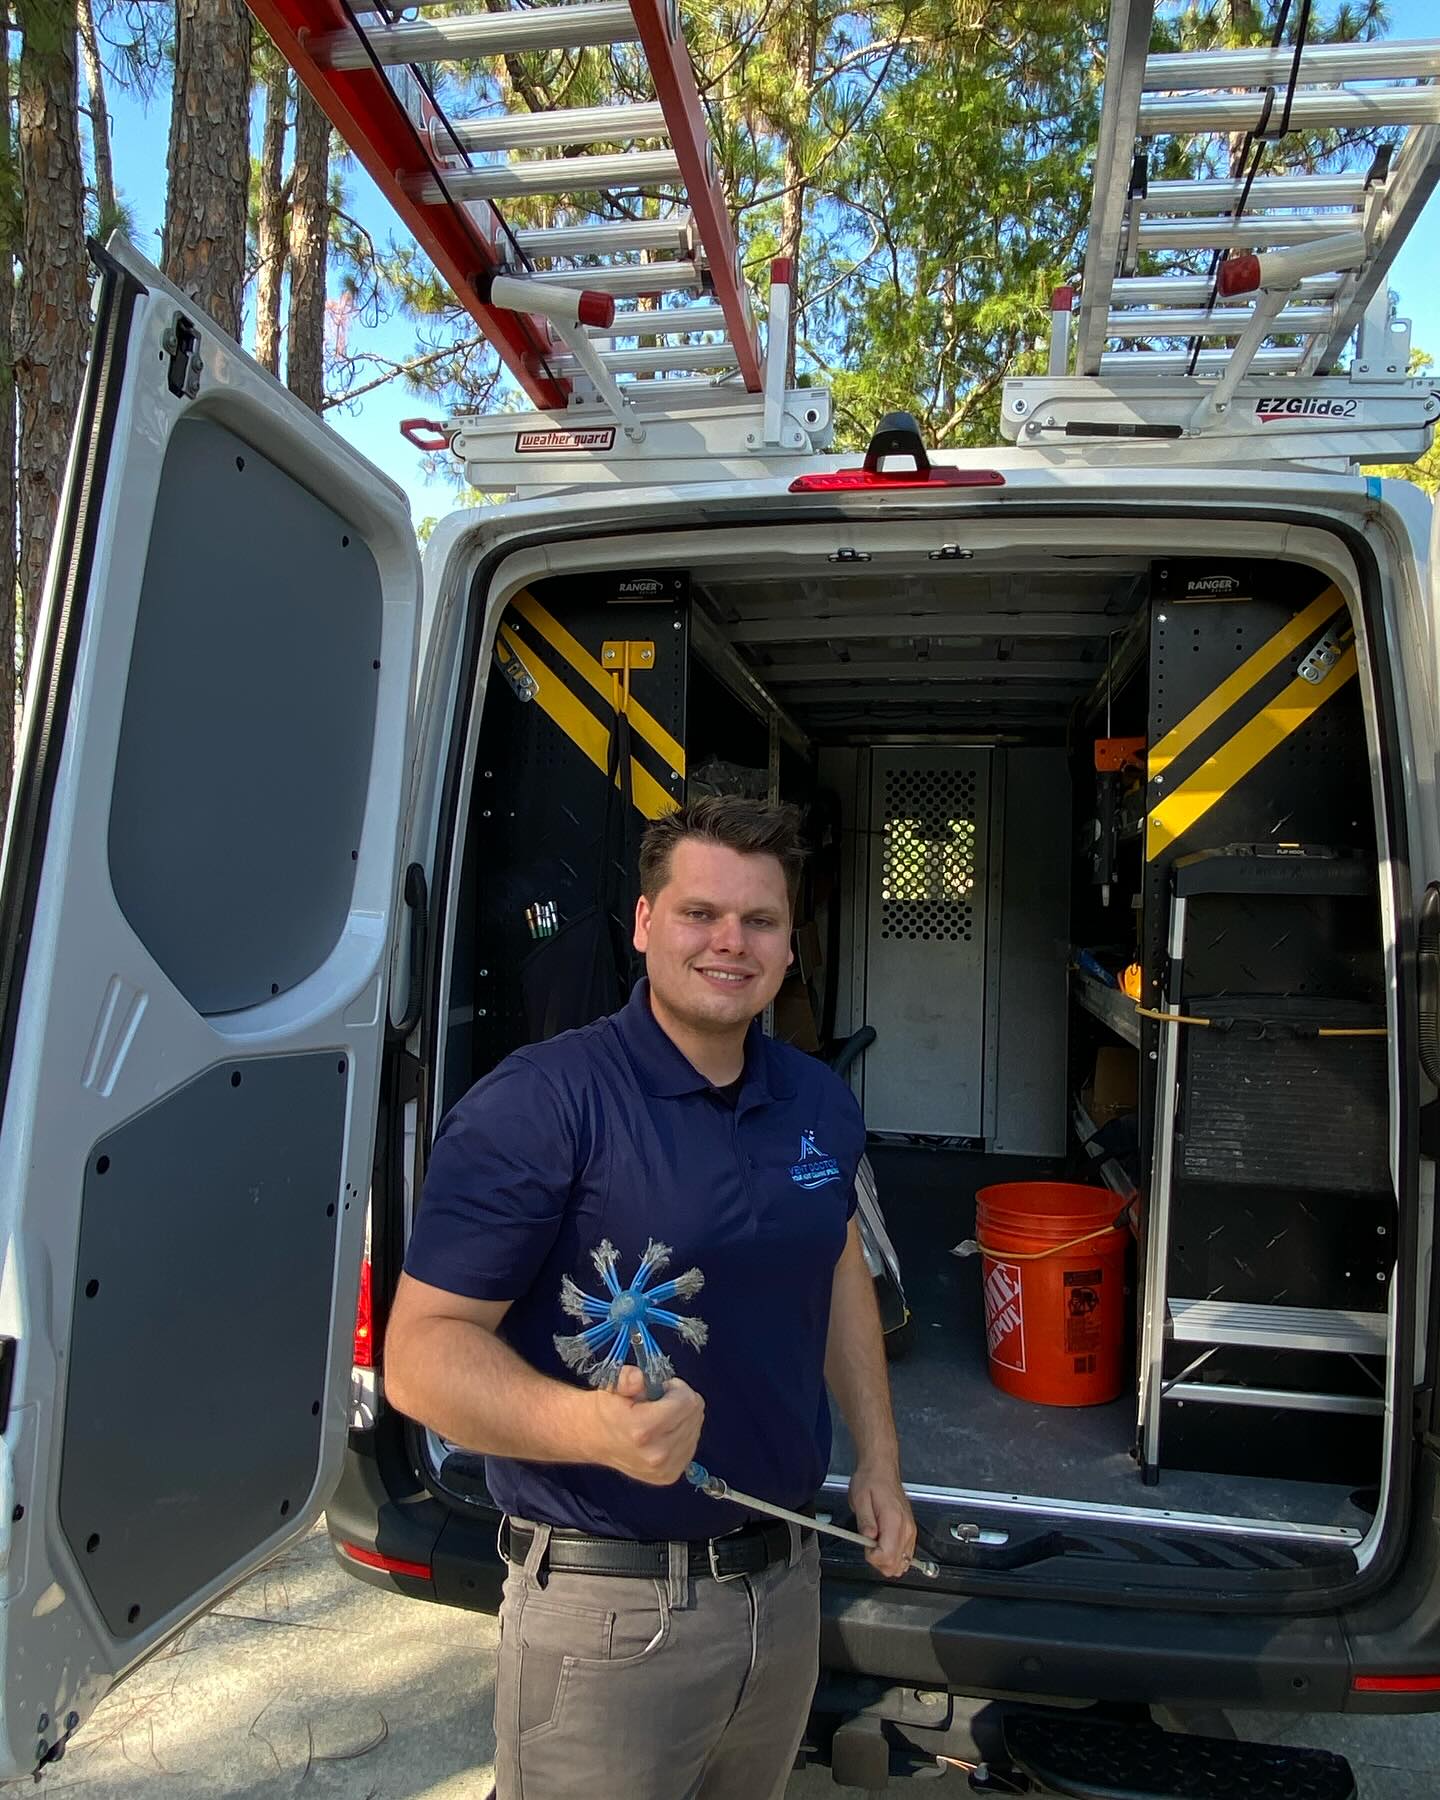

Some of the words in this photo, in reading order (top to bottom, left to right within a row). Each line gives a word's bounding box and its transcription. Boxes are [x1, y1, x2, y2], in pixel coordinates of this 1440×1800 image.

[1255, 398, 1358, 417] EZGlide2
[522, 433, 571, 446] weather
[574, 431, 609, 446] guard
[619, 582, 657, 592] RANGER
[1188, 579, 1232, 591] RANGER
